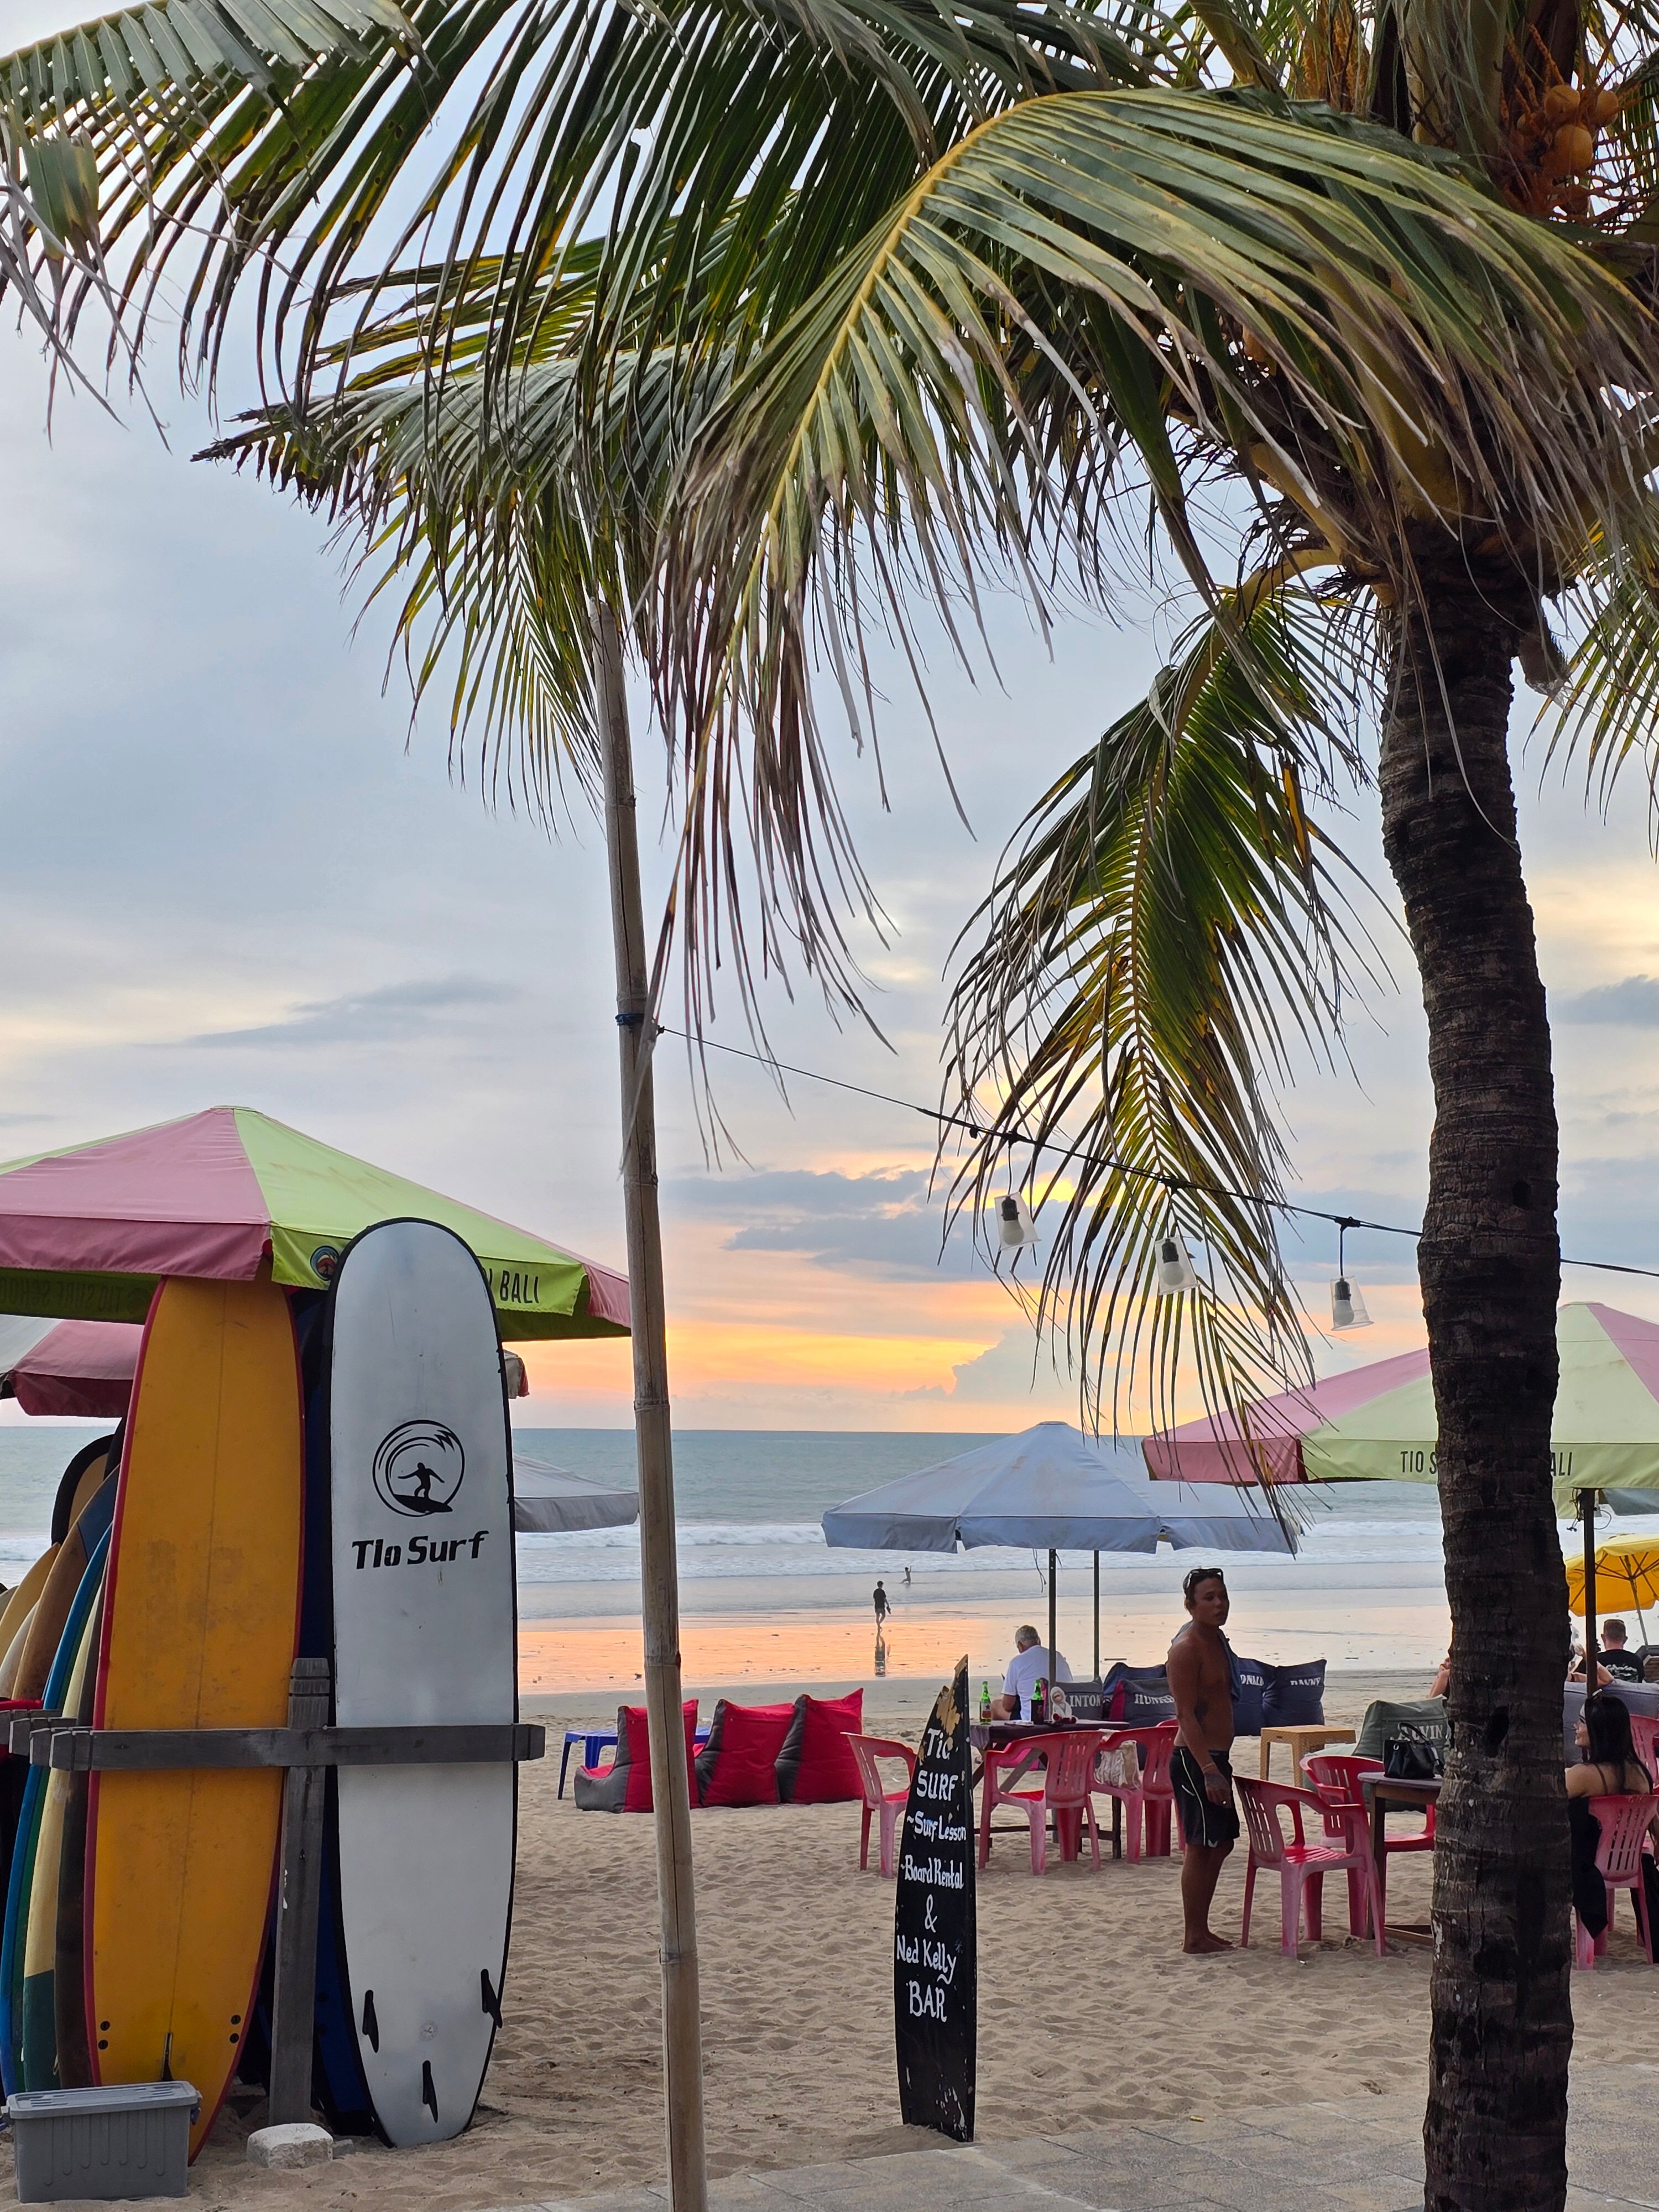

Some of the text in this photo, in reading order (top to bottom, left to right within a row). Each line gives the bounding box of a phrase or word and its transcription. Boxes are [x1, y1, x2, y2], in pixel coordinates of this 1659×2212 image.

[499, 1270, 539, 1303] BALI
[1400, 1451, 1424, 1473] TIO
[1550, 1452, 1573, 1476] ALI
[407, 1530, 489, 1565] Surf
[1069, 1694, 1100, 1708] INTON
[917, 1770, 958, 1801] SURF
[938, 1815, 967, 1841] Lesson
[933, 1858, 964, 1889] Rental
[925, 1894, 937, 1933] &
[896, 1934, 957, 1985] Ned Kelly
[909, 1980, 947, 2023] BAR
